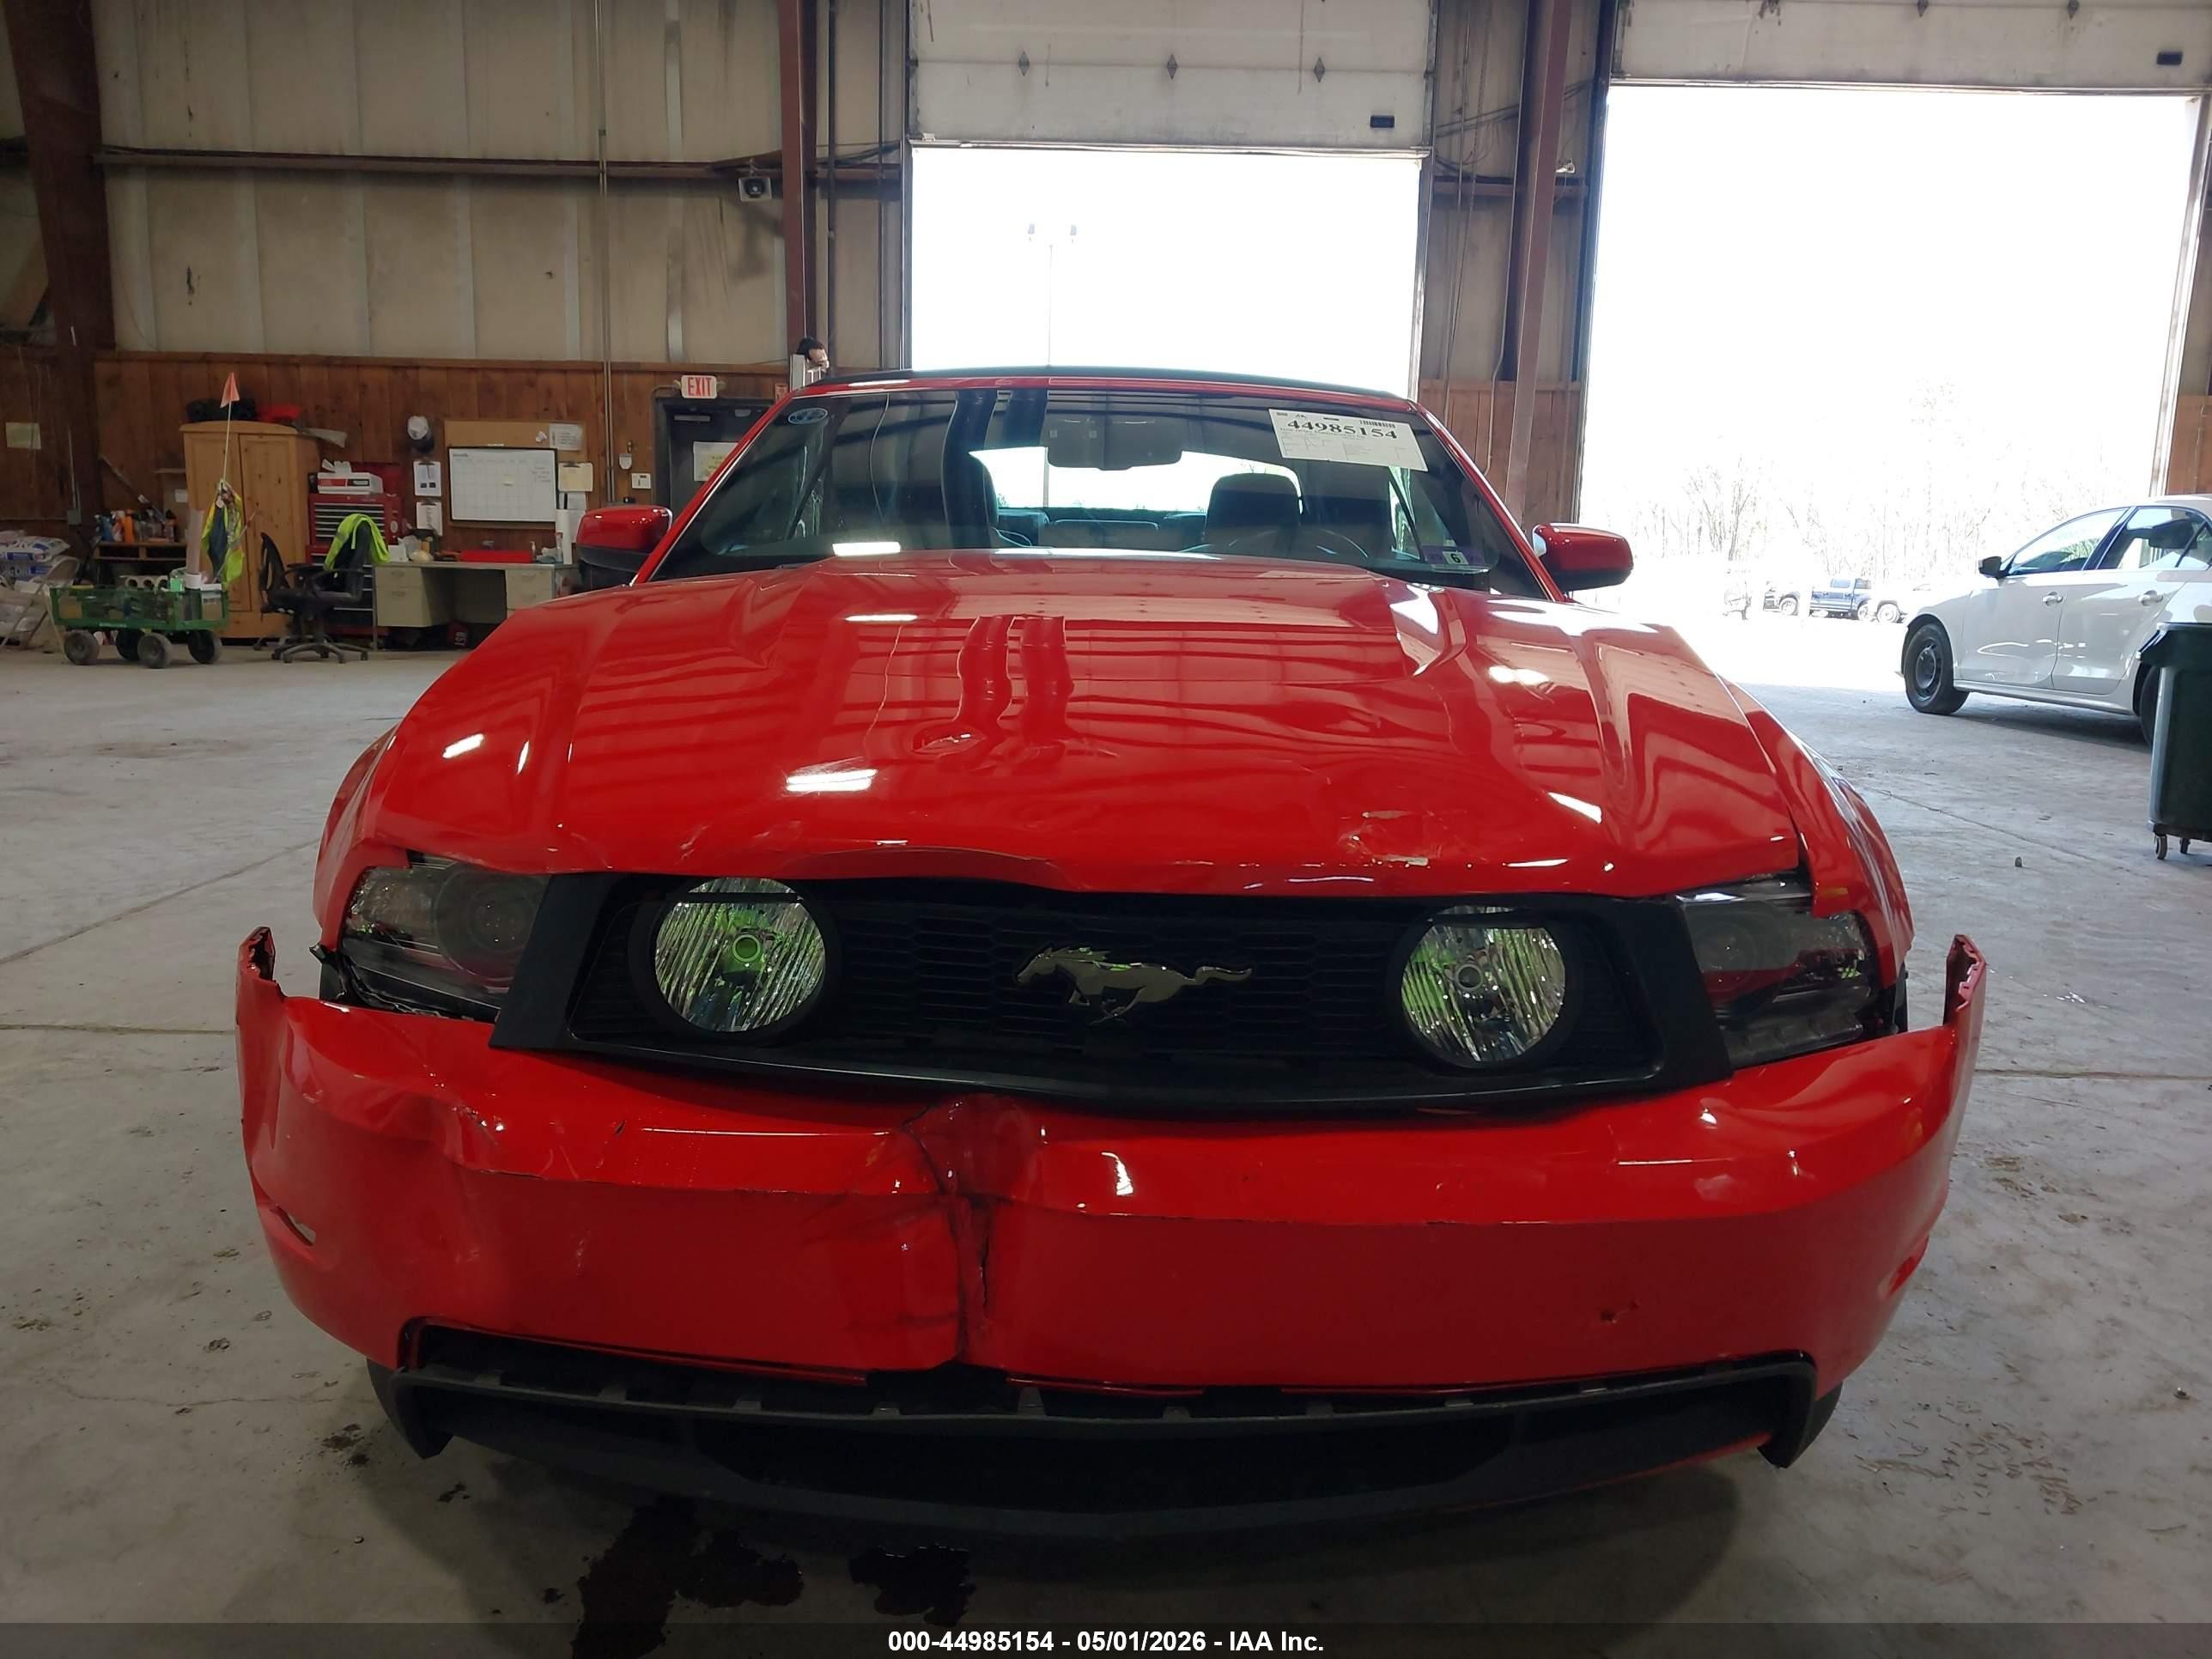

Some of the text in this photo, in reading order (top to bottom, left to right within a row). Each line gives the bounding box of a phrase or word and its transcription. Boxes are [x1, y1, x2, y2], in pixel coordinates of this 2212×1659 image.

[687, 377, 712, 397] EXIT
[1287, 420, 1397, 439] 44985154
[1449, 552, 1462, 564] 6
